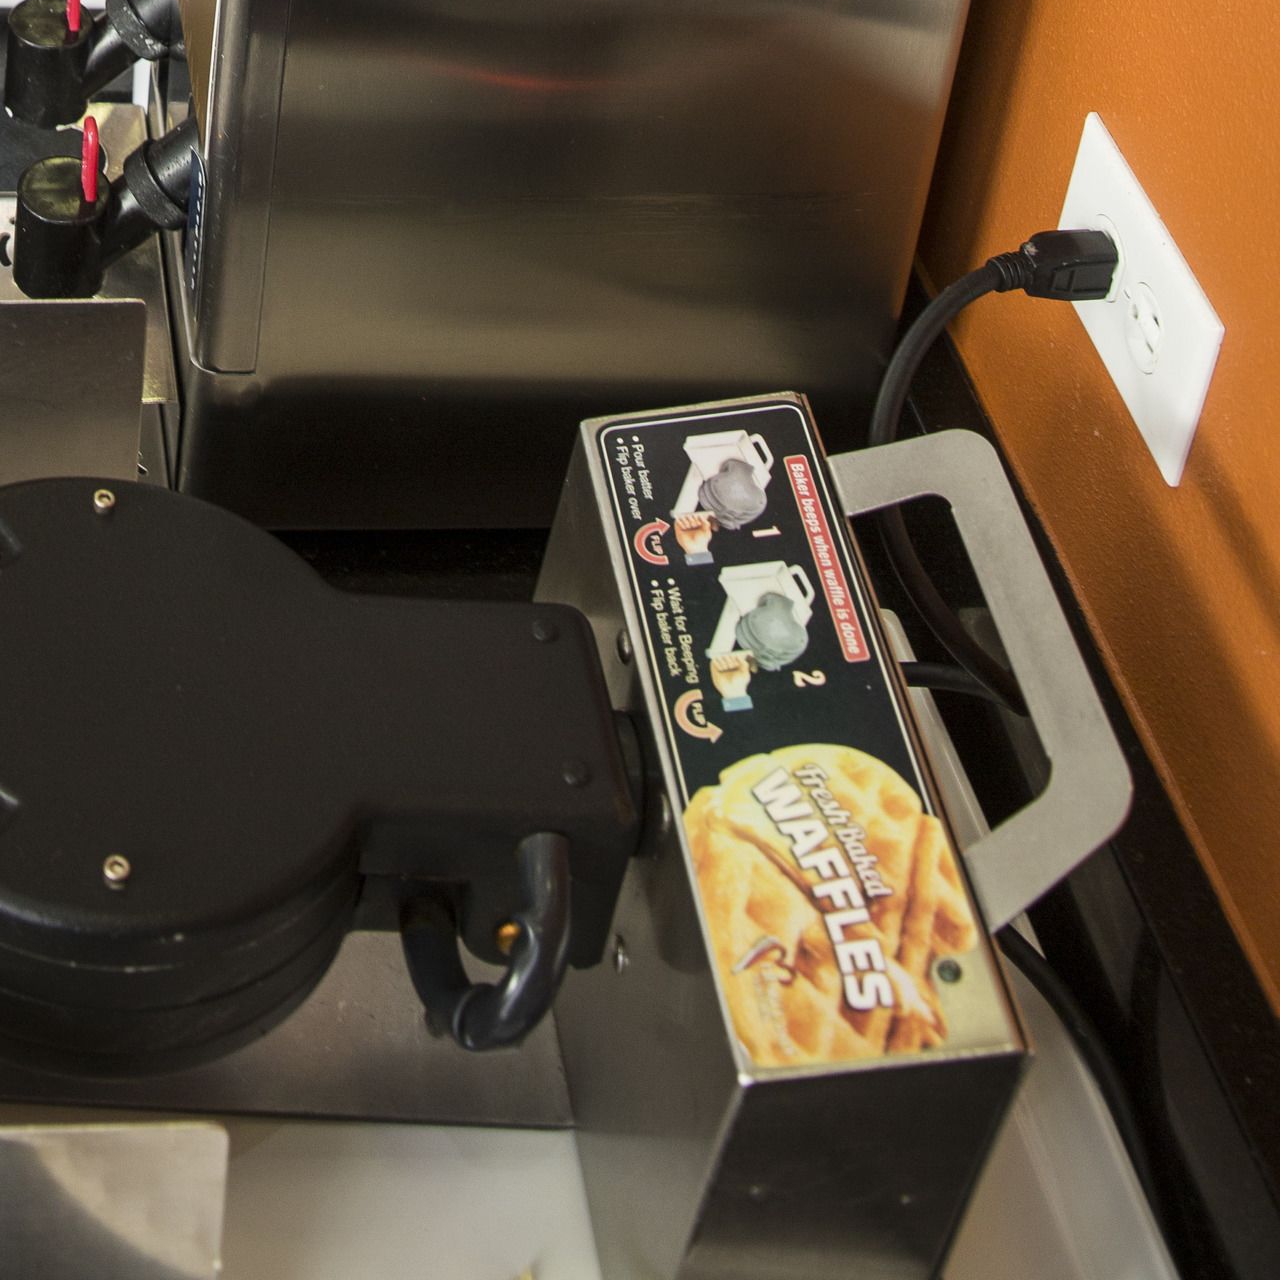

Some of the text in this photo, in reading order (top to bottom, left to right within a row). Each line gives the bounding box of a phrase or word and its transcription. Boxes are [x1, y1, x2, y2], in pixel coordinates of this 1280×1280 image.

[616, 446, 642, 521] Flip baker over
[632, 443, 654, 500] Pour batter
[650, 534, 664, 555] FLIP
[752, 525, 782, 538] 1
[790, 462, 860, 655] Baker beeps when waffle is done
[650, 589, 682, 677] Flip baker back
[668, 586, 700, 684] Wait for Beeping
[691, 702, 707, 726] FLIP
[792, 669, 826, 688] 2
[793, 763, 893, 898] Fresh Baked
[752, 767, 894, 1010] WAFFLES
